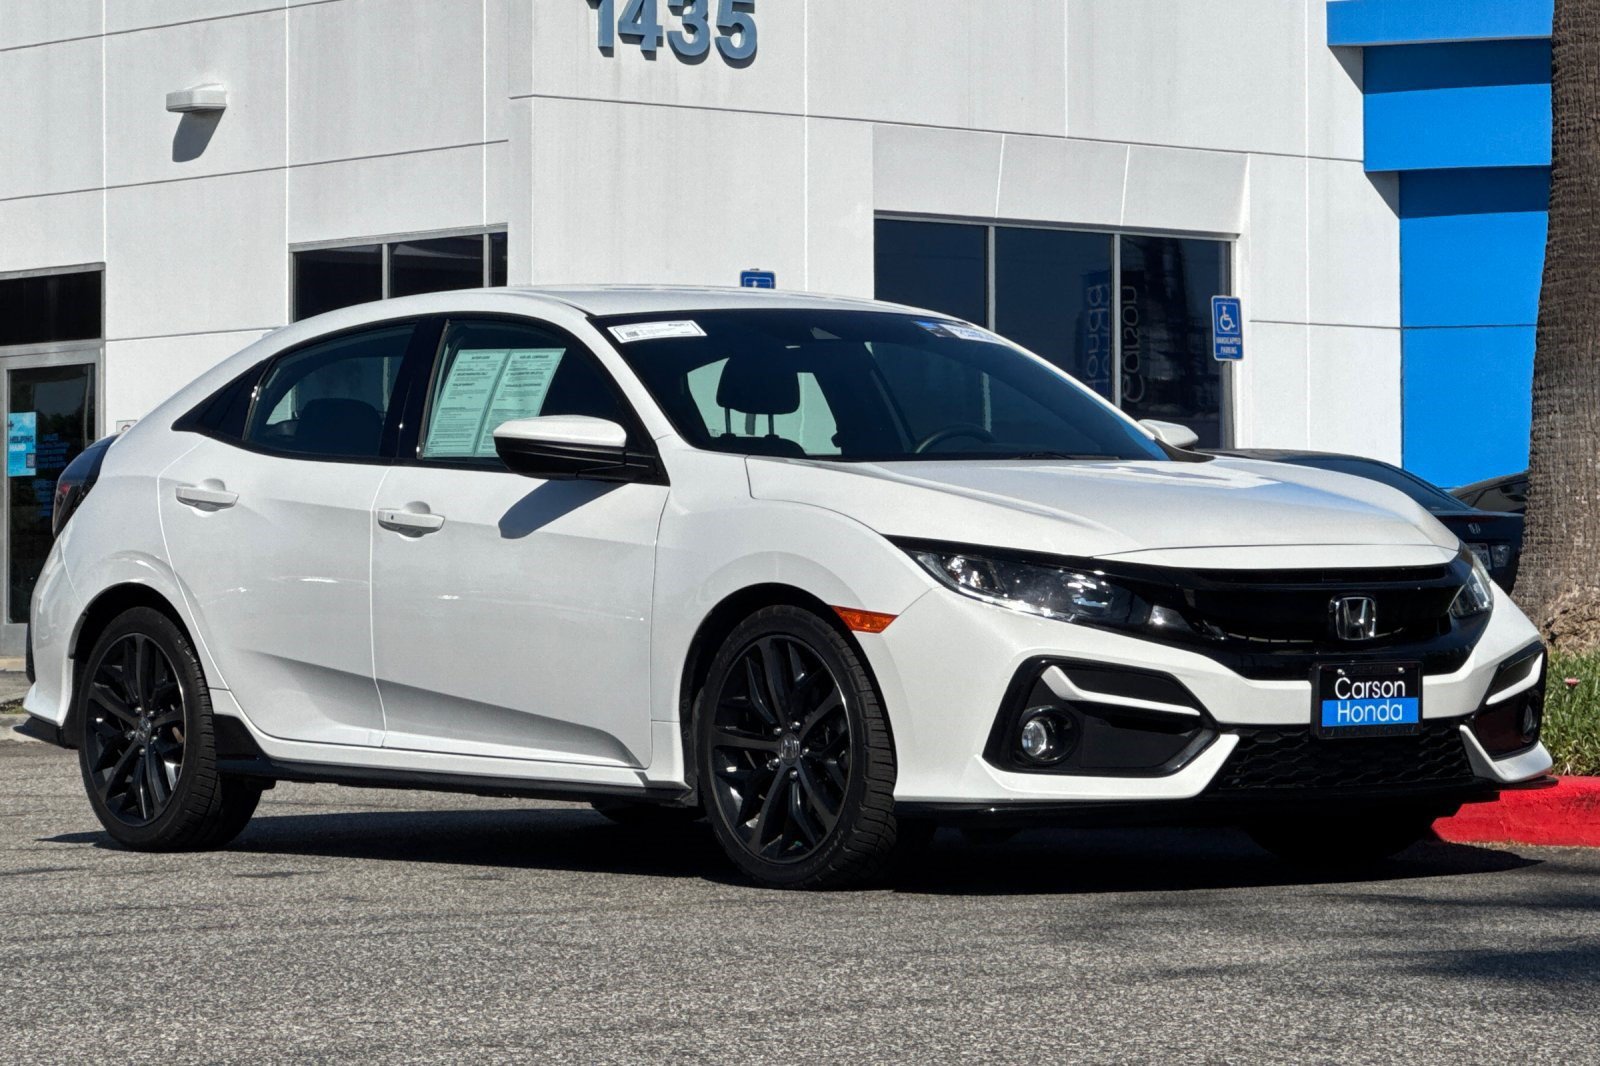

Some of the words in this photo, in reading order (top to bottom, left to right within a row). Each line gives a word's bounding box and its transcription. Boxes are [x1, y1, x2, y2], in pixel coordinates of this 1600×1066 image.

[589, 0, 757, 60] 1435
[1335, 677, 1406, 699] Carson
[1337, 700, 1403, 723] Honda
